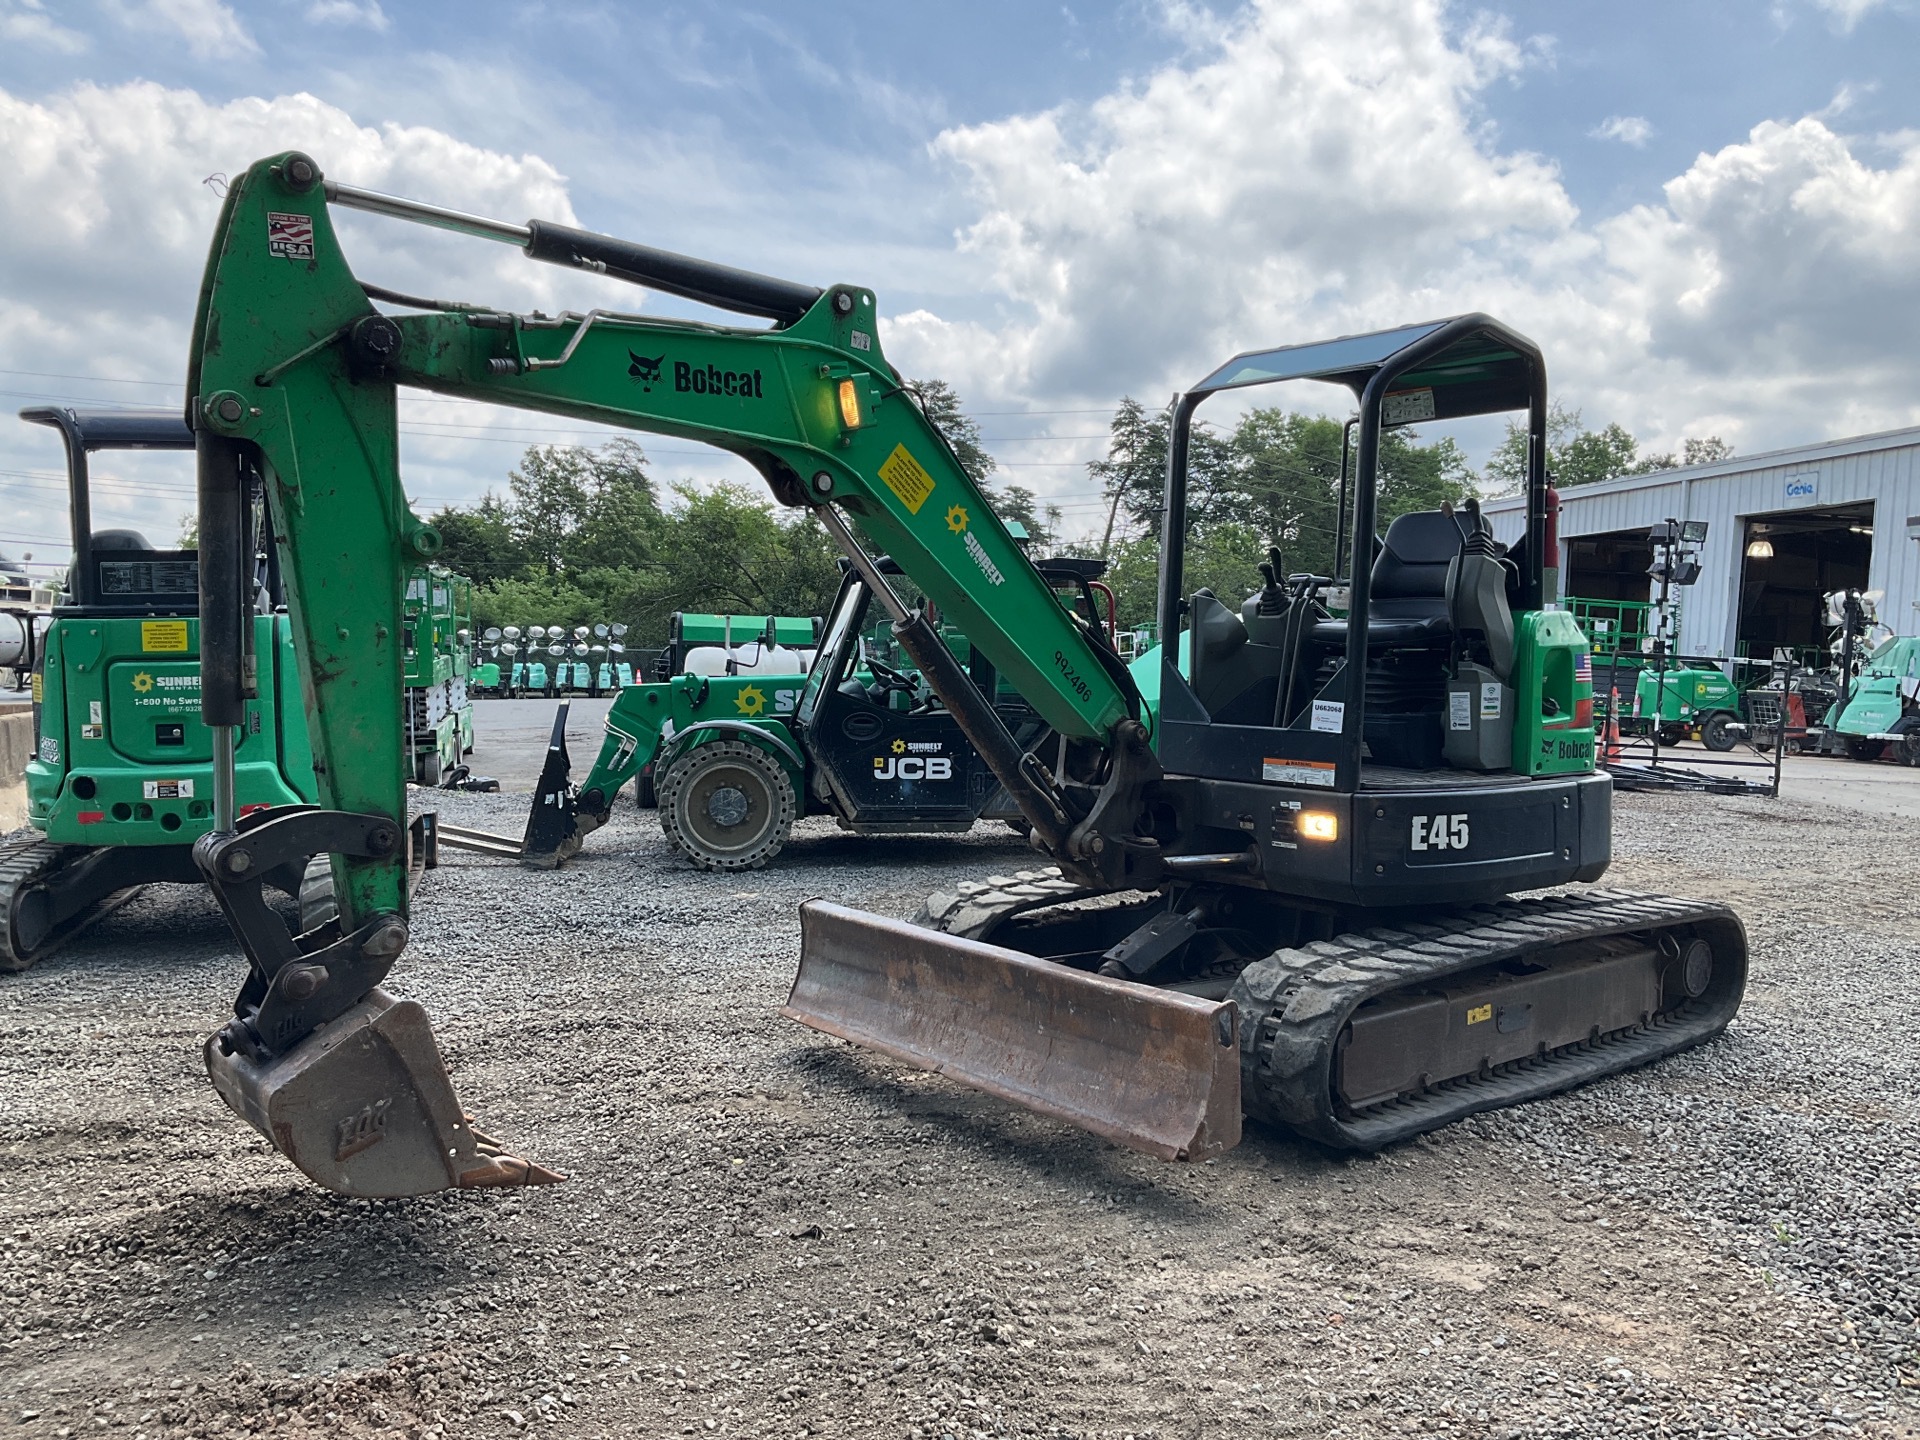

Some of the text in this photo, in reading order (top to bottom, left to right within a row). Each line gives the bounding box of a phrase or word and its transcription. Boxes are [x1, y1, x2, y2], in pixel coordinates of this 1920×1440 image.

[272, 242, 310, 254] USA
[674, 361, 762, 398] Bobcat
[1787, 483, 1813, 496] Genie
[964, 531, 1005, 586] SUNBELT
[965, 545, 993, 584] RENTALS
[157, 676, 201, 687] SUNBE
[1055, 651, 1092, 702] 992406
[163, 697, 176, 705] No
[874, 757, 951, 780] JCB
[1411, 814, 1469, 850] E45
